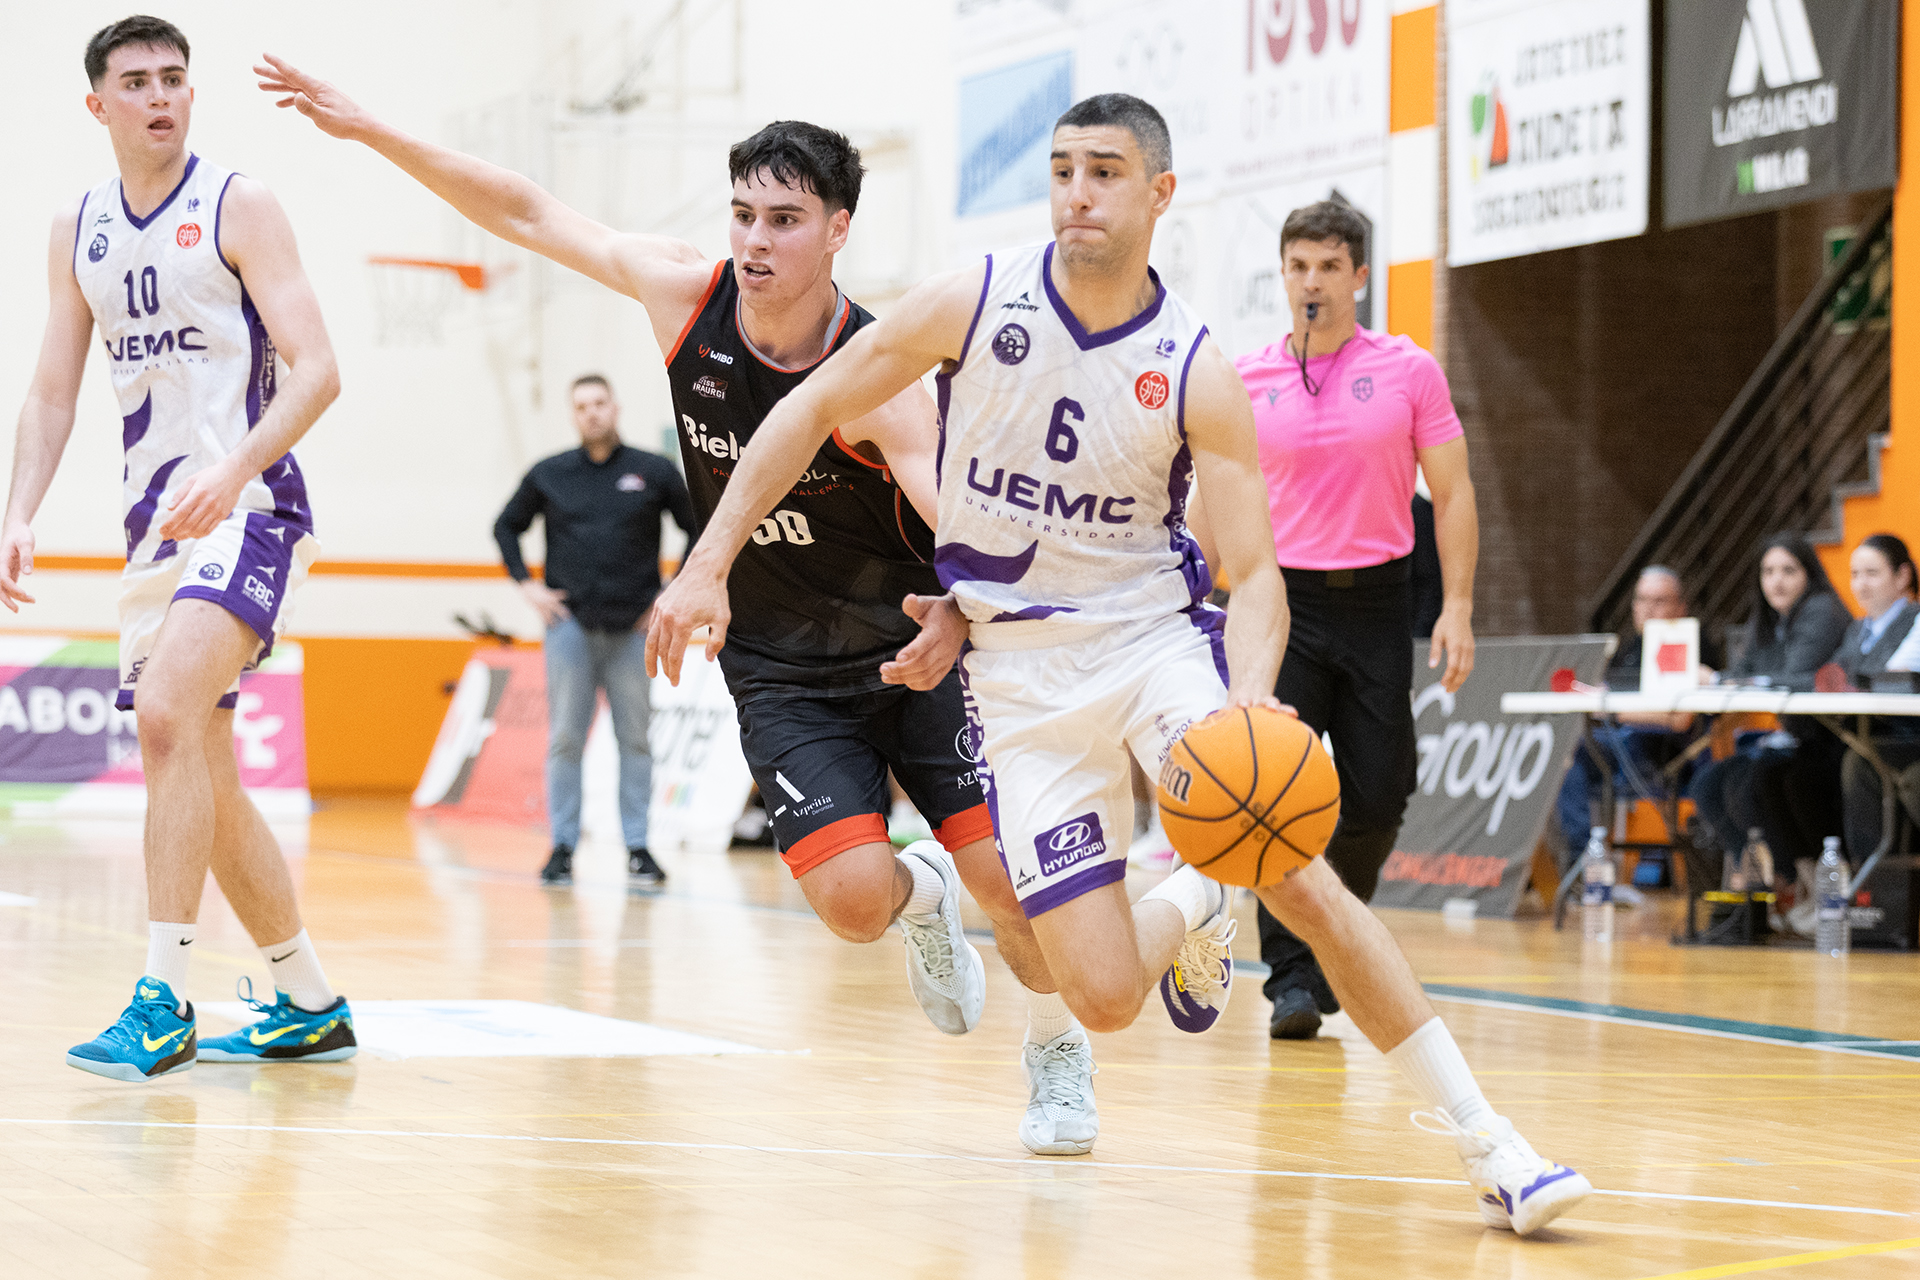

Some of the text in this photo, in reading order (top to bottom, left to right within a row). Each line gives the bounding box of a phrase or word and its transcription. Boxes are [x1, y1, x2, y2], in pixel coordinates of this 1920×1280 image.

[124, 265, 160, 319] 10
[106, 326, 208, 362] UEMC
[710, 350, 734, 365] WIBO
[692, 382, 726, 399] IRAURGI
[682, 413, 746, 461] Biel
[1044, 396, 1086, 464] 6
[787, 482, 854, 497] HALLENGS
[967, 456, 1136, 524] UEMC
[965, 496, 1134, 539] UNIVERSIDAD
[243, 574, 275, 607] CBC
[1044, 841, 1104, 874] HYUNDAI
